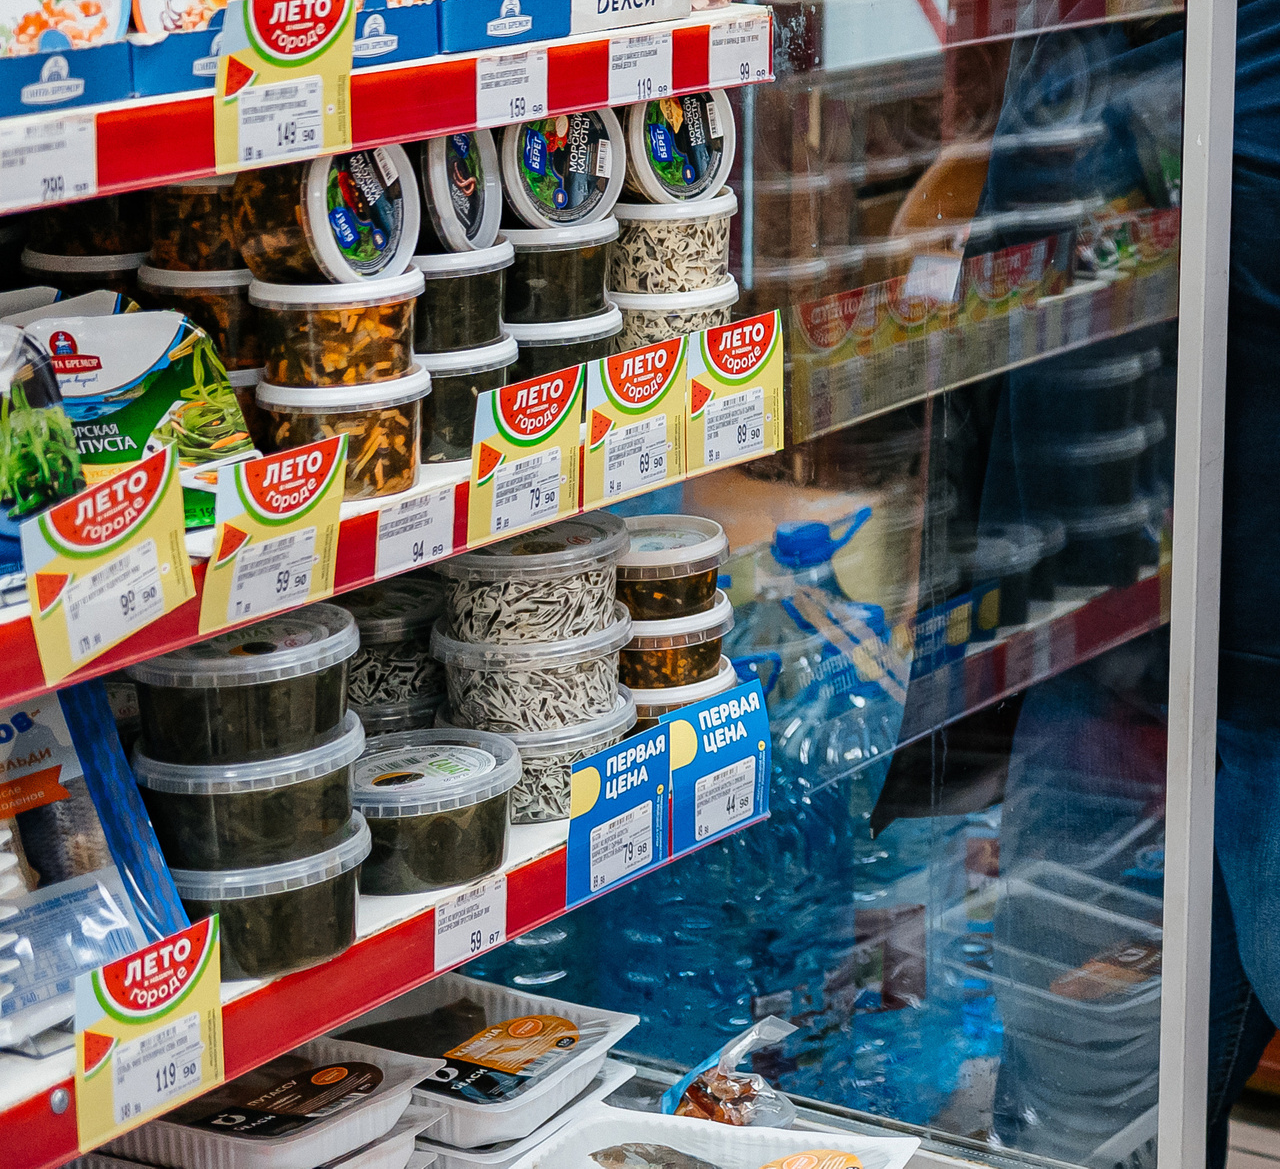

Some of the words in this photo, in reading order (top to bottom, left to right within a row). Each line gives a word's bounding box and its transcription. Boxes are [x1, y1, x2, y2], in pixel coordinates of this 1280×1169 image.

[271, 23, 326, 52] городе
[740, 63, 750, 80] 99
[637, 78, 651, 99] 119
[510, 99, 526, 118] 159
[684, 97, 697, 146] МОРСКОЙ
[691, 98, 703, 146] КАПУСТЫ
[532, 136, 542, 169] БЕРЕГ
[569, 113, 582, 172] МОРСКОЙ
[577, 117, 590, 174] КАПУСТЫ
[719, 323, 765, 351] ЛЕТО
[621, 349, 667, 379] ЛЕТО
[722, 346, 761, 373] городе
[513, 379, 563, 411] ЛЕТО
[623, 373, 663, 402] городе
[72, 424, 119, 438] ОРСКАЯ
[515, 403, 558, 434] городе
[77, 436, 138, 454] АПУСТА
[738, 424, 747, 444] 89
[751, 428, 760, 439] 90
[262, 451, 323, 488] ЛЕТО
[640, 453, 649, 474] 69
[654, 456, 663, 468] 90
[75, 470, 148, 527] ЛЕТО
[266, 477, 317, 512] городе
[530, 488, 540, 510] 79
[545, 491, 555, 504] 90
[82, 497, 145, 542] городе
[413, 540, 424, 562] 94
[432, 544, 443, 556] 89
[276, 570, 290, 593] 59
[699, 692, 760, 730] ПЕРВАЯ
[703, 721, 748, 754] ЦЕНА
[606, 735, 666, 777] ПЕРВАЯ
[606, 765, 648, 800] ЦЕНА
[726, 794, 736, 815] 44
[739, 796, 749, 808] 98
[623, 842, 633, 863] 79
[638, 843, 647, 856] 98
[470, 931, 482, 952] 59
[489, 931, 500, 945] 87
[124, 939, 191, 987] ЛЕТО
[129, 966, 187, 1008] городе
[156, 1063, 176, 1092] 119
[183, 1063, 196, 1079] 90
